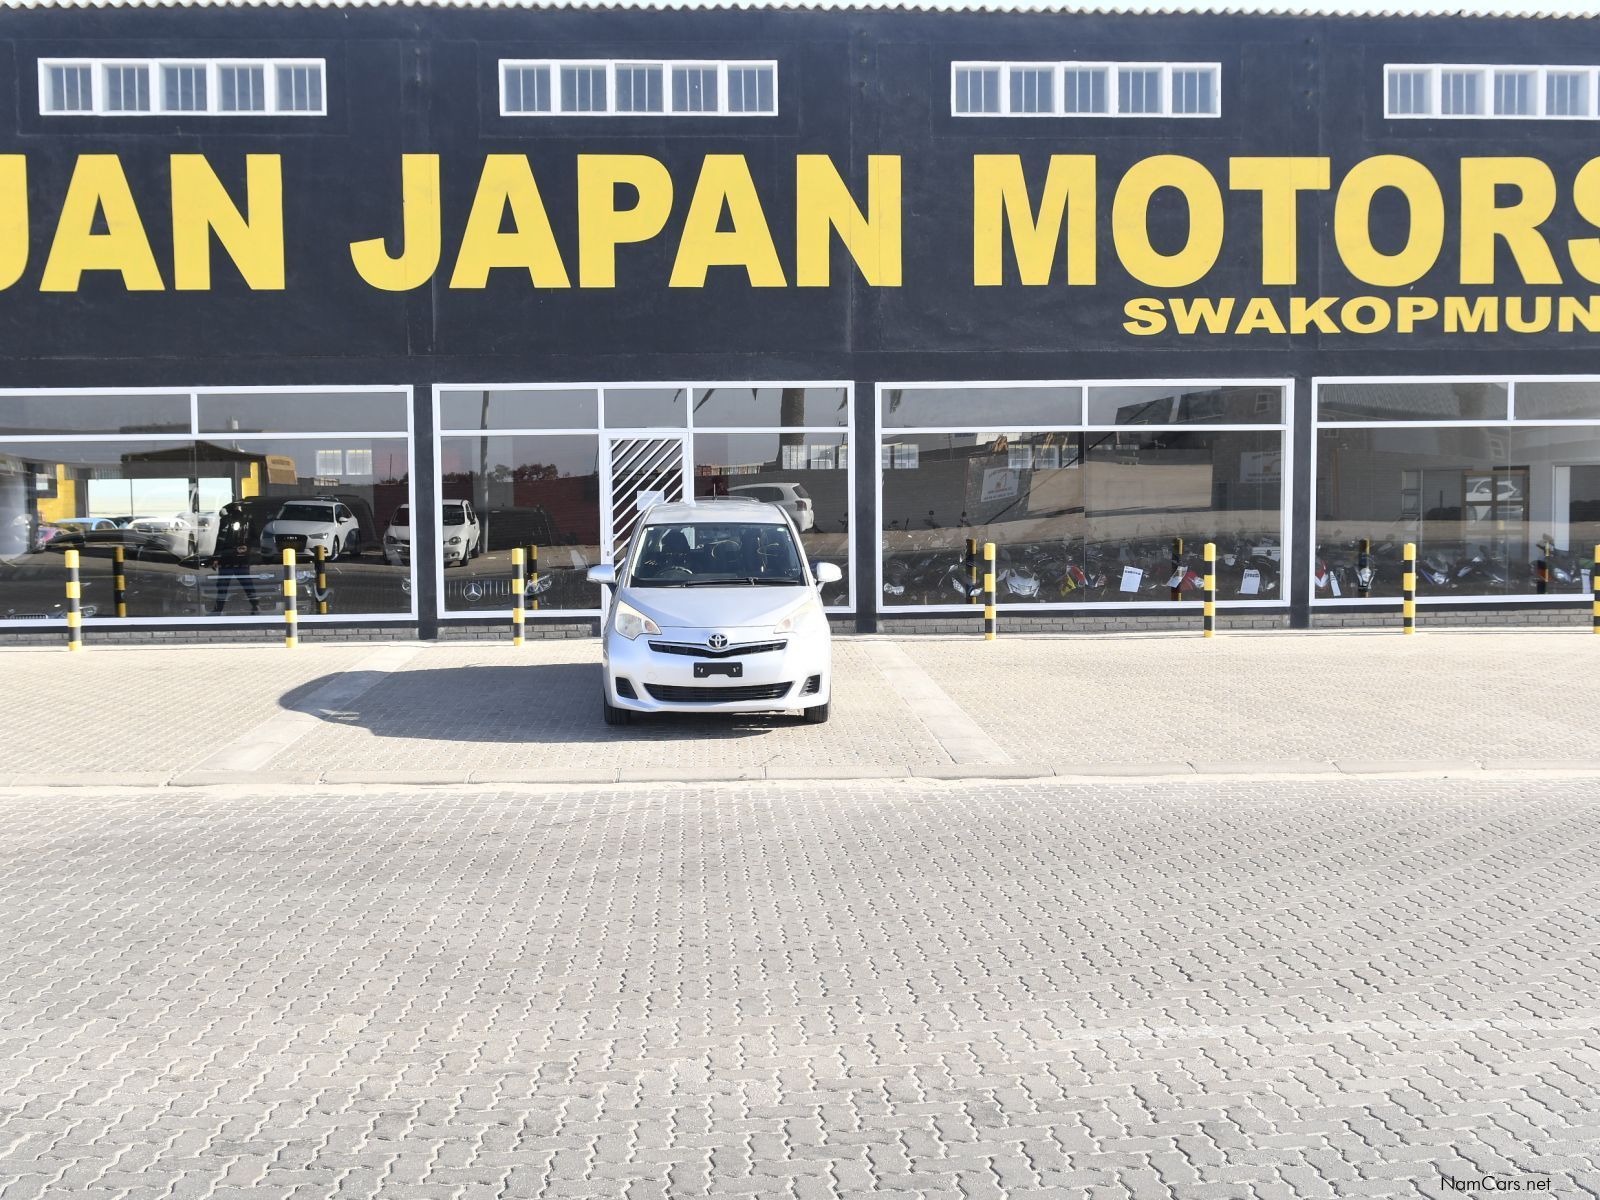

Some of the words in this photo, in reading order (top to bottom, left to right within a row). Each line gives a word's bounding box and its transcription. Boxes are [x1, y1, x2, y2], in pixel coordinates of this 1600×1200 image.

[0, 154, 285, 292] AN
[350, 154, 903, 291] JAPAN
[1123, 295, 1600, 336] SWAKOPMUN
